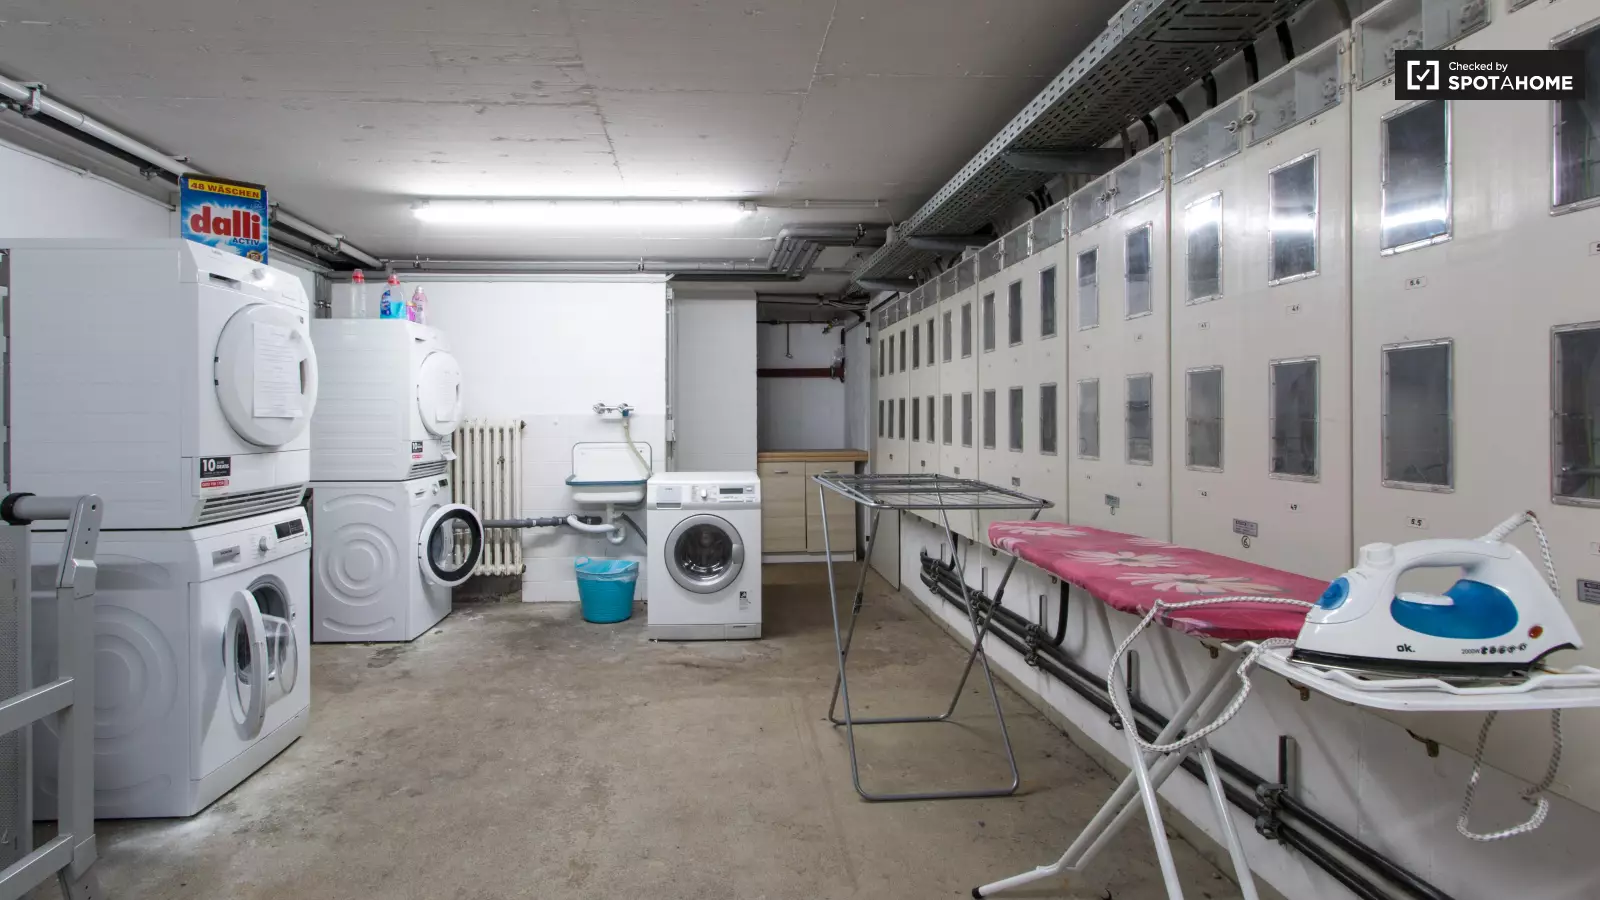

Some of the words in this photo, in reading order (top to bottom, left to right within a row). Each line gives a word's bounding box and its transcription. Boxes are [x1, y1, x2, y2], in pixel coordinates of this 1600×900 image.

[208, 184, 259, 198] WÄSCHEN
[190, 205, 260, 240] dalli
[232, 237, 260, 246] ACTIV
[202, 459, 216, 472] 10
